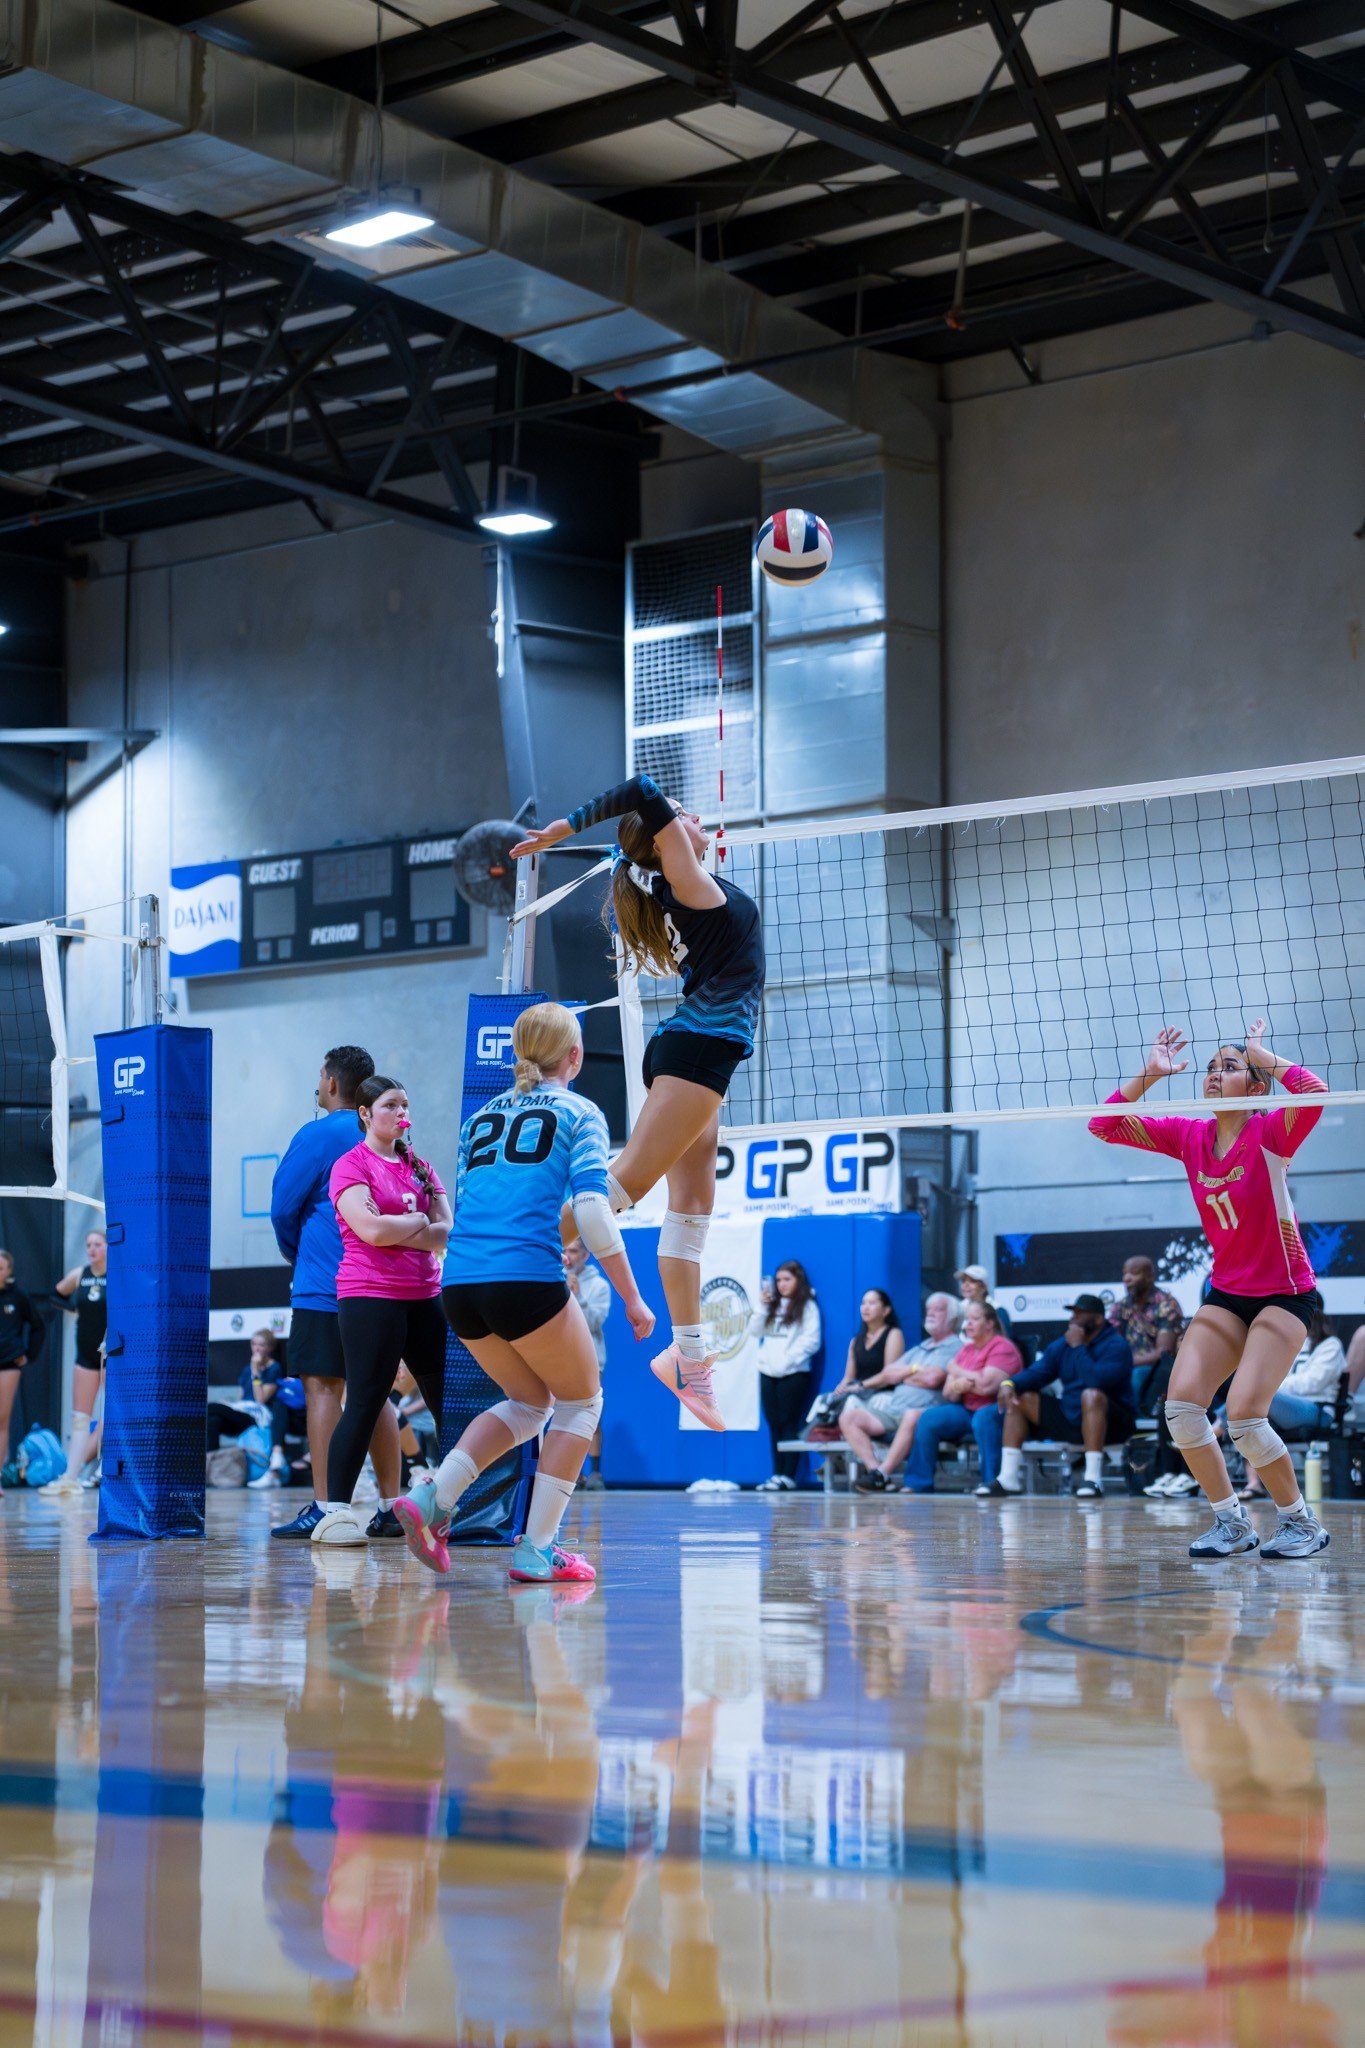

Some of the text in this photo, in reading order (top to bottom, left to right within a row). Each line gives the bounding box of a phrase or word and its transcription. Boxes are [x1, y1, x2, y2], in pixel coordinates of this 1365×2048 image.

[409, 839, 457, 865] HOME
[249, 858, 302, 885] GUEST
[174, 899, 235, 931] DASANI
[310, 922, 360, 946] PERIOD
[477, 1026, 514, 1059] GP
[113, 1056, 146, 1089] GP
[485, 1095, 558, 1111] VAN DAM
[466, 1109, 557, 1172] 20
[745, 1138, 813, 1199] GP
[825, 1132, 895, 1194] GP
[401, 1192, 417, 1214] 3
[1205, 1190, 1239, 1230] 11
